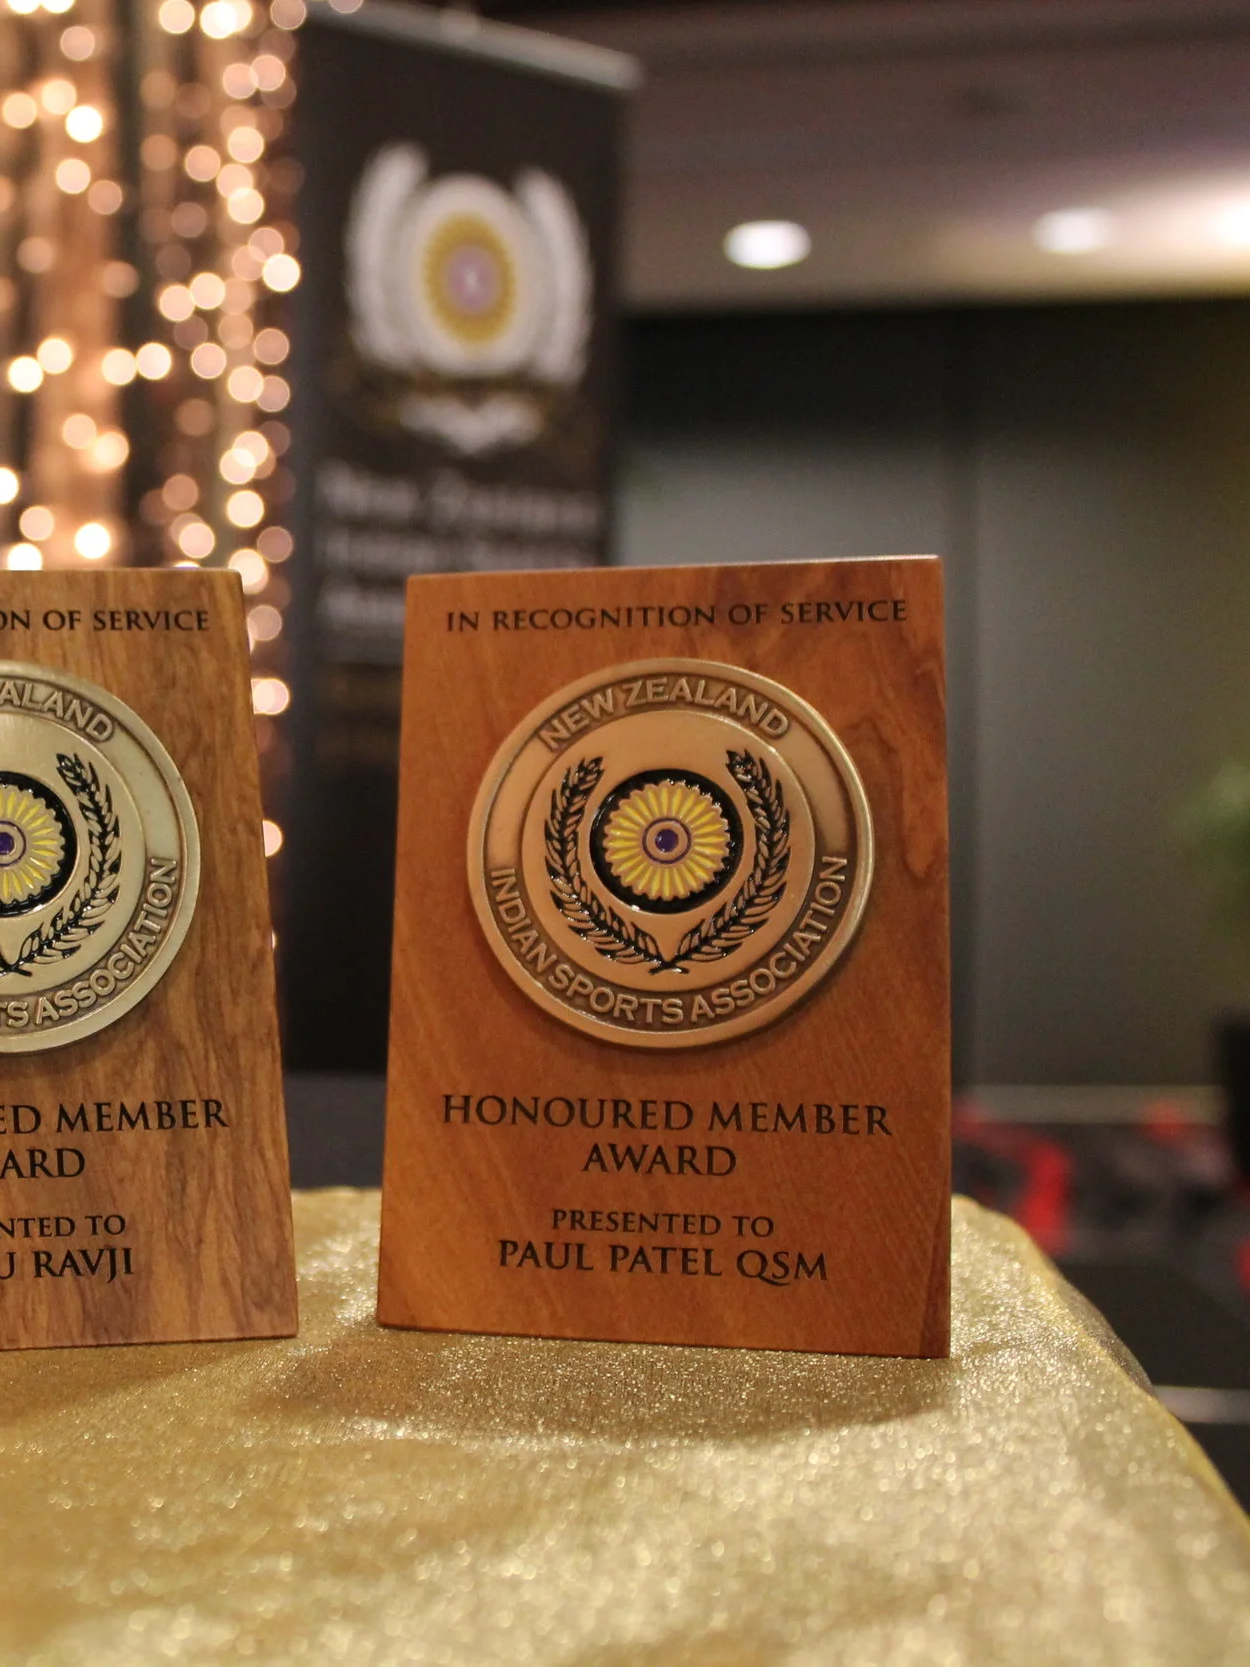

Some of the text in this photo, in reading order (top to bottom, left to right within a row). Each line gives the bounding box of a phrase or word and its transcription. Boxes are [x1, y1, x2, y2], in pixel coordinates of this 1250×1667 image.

[43, 609, 82, 631] OF
[93, 609, 210, 632] SERVICE
[446, 599, 907, 633] IN RECOGNITION OF SERVICE
[537, 677, 789, 751] NEW ZEALAND
[34, 858, 177, 1024] ASSOCIATION
[491, 855, 848, 1025] INDIAN SPORTS ASSOCIATION
[55, 1099, 229, 1134] MEMBER
[442, 1094, 892, 1136] HONOURED MEMBER
[582, 1142, 736, 1177] AWARD
[85, 1214, 126, 1236] TO
[551, 1209, 774, 1238] PRESENTED TO
[33, 1247, 134, 1284] RAVJI
[498, 1239, 828, 1286] PAUL PATEL QSM
